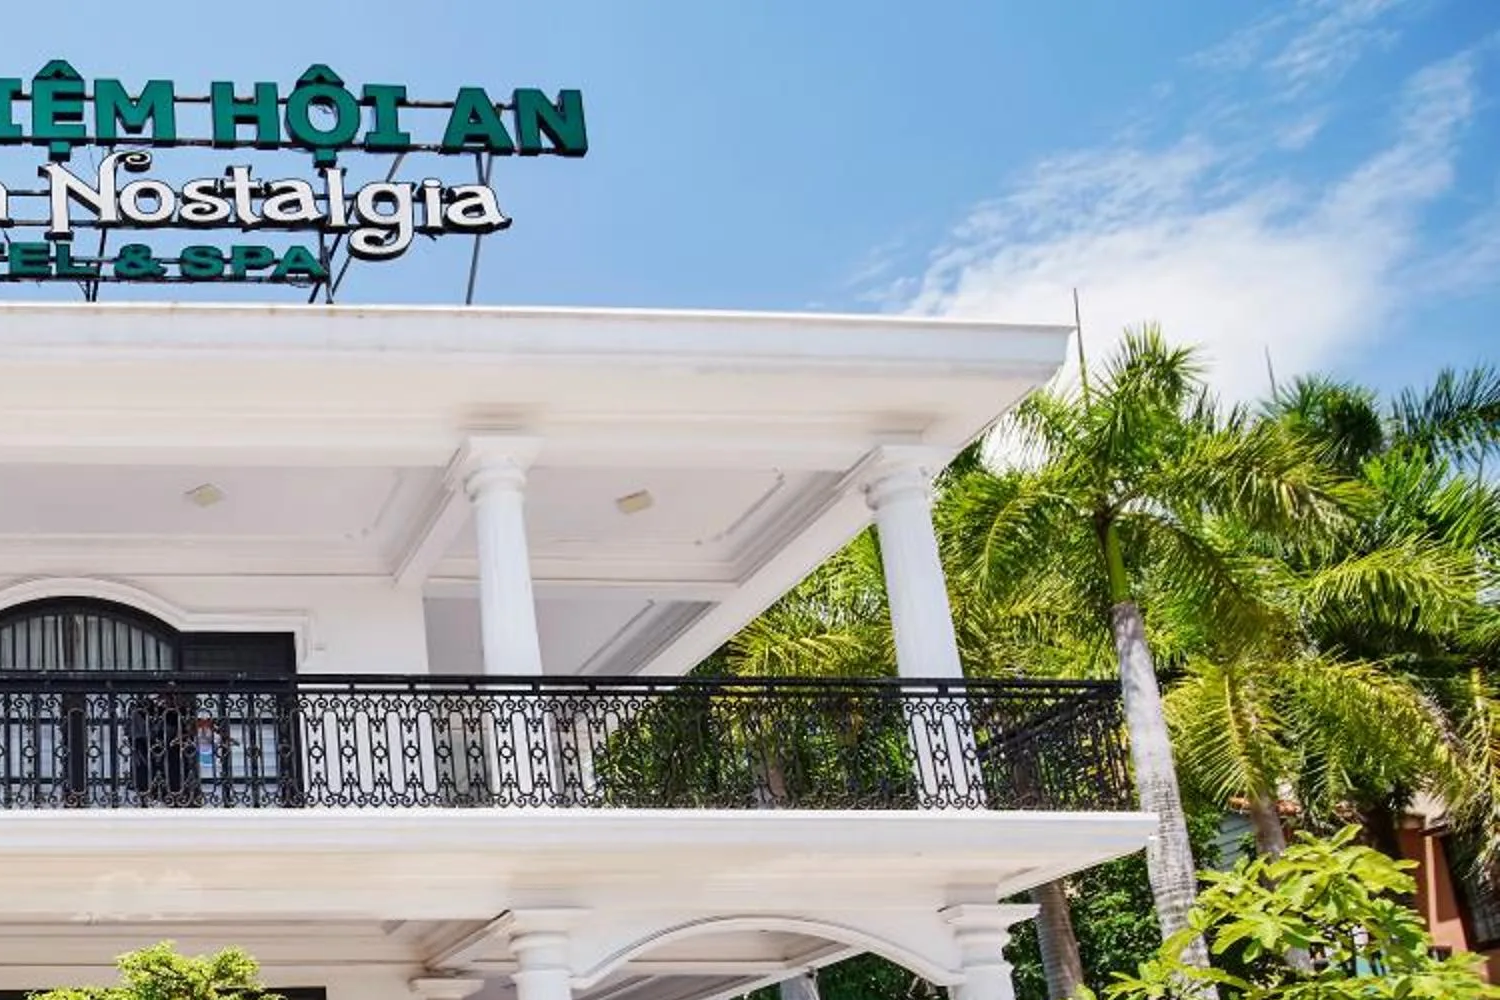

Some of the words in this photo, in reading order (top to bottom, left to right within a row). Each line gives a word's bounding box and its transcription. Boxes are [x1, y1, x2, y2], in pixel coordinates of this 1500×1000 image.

[210, 64, 410, 168] HỘI
[442, 87, 588, 157] AN
[38, 151, 512, 260] Nostalgia
[113, 243, 168, 280] &
[180, 244, 329, 281] SPA
